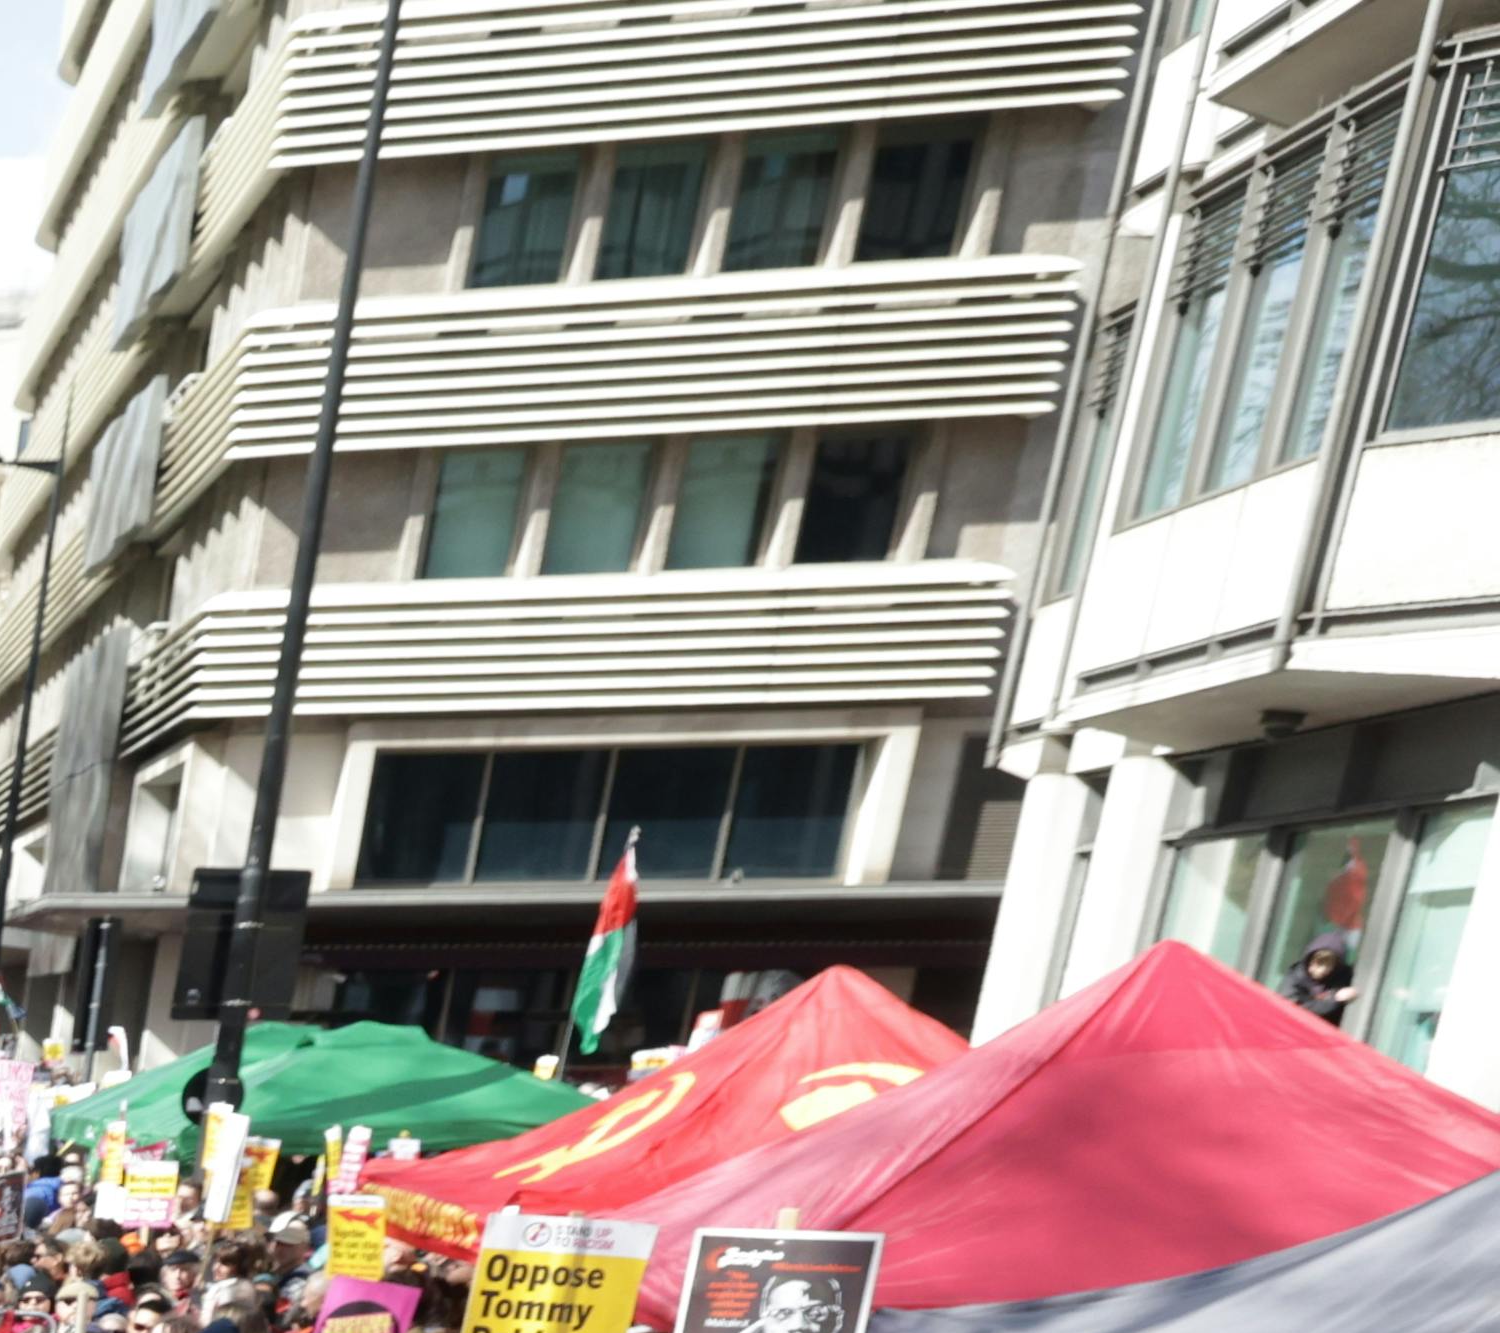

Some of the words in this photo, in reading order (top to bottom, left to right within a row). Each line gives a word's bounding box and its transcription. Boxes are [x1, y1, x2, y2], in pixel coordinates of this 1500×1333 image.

[557, 1224, 592, 1239] STAND
[595, 1226, 613, 1239] UP
[485, 1253, 605, 1291] Oppose
[479, 1289, 593, 1330] Tommy
